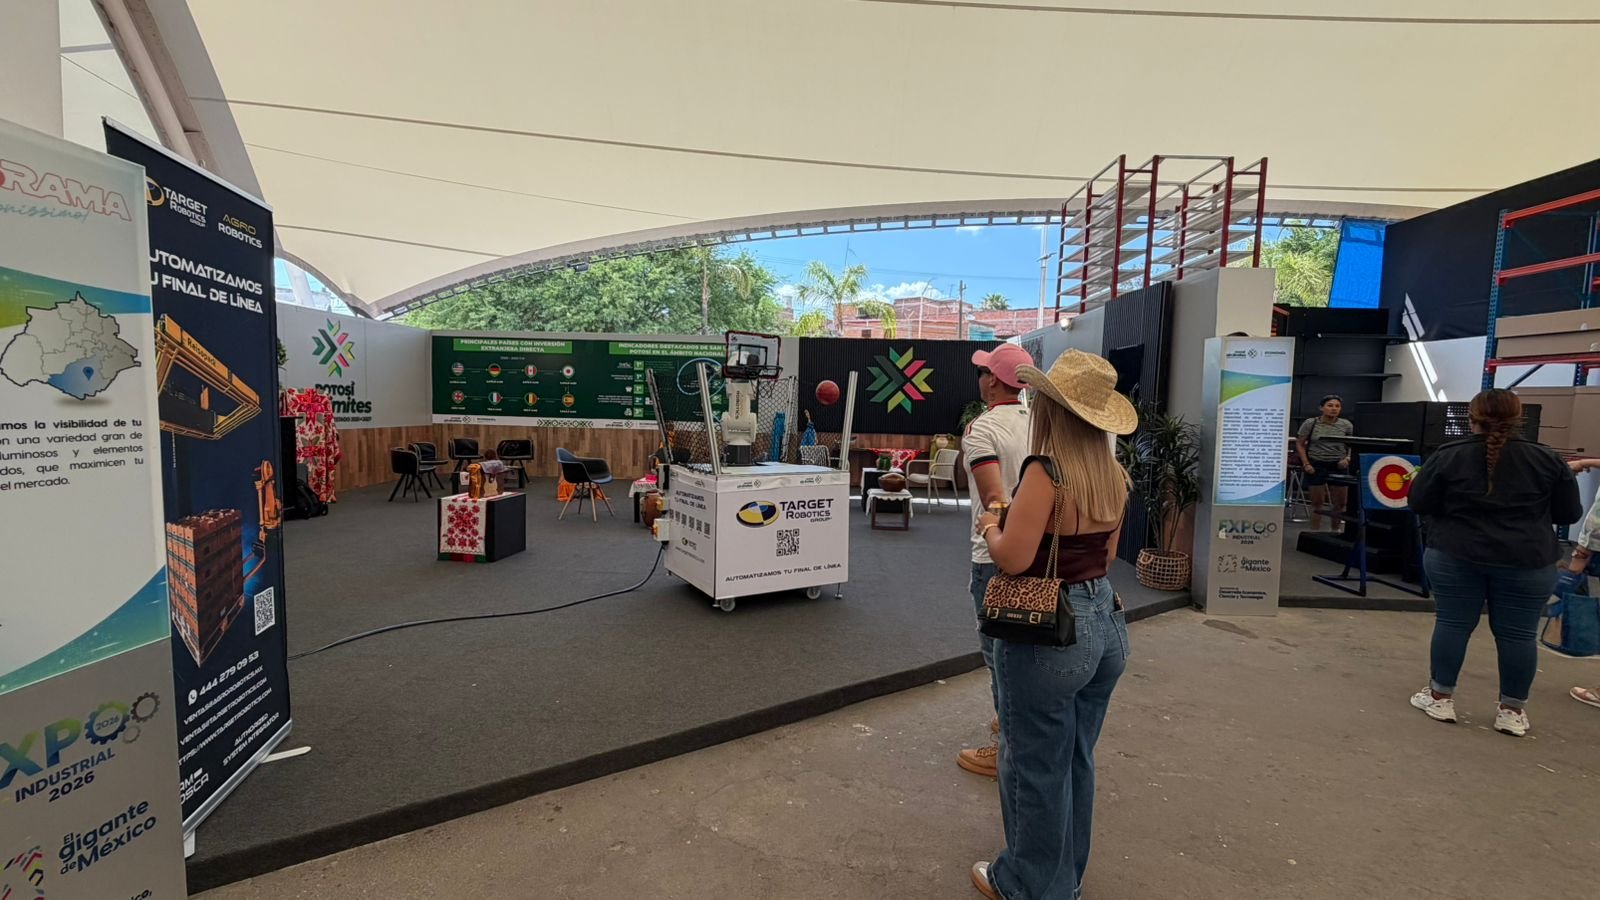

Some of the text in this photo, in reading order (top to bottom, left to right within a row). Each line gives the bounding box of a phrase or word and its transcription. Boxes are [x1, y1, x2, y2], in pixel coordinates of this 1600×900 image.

[163, 186, 208, 216] TARGET
[189, 218, 206, 228] GROUP
[222, 214, 257, 236] AGRO
[217, 222, 263, 249] ROBOTICS
[162, 274, 207, 299] FINAL
[210, 288, 228, 304] DE
[230, 292, 264, 314] LÍNEA
[0, 419, 142, 431] mos la visibilidad de tu
[16, 436, 40, 445] una
[46, 431, 97, 444] variedad
[101, 431, 125, 443] gran
[129, 431, 143, 440] de
[72, 449, 80, 458] y
[93, 444, 143, 455] elementos
[36, 463, 59, 475] que
[69, 459, 126, 471] maximicen
[134, 456, 144, 465] tu
[0, 475, 70, 492] el mercado.
[779, 498, 834, 512] TARGET
[725, 571, 782, 582] AUTOMATIZAMOS
[823, 562, 842, 571] LÍNEA
[1241, 559, 1270, 567] gigante
[199, 650, 260, 697] 444 279 09 53
[95, 714, 120, 732] 2026
[223, 712, 280, 766] SYSTEM INTEGRATOR
[15, 747, 116, 803] INDUSTRIAL
[48, 770, 95, 803] 2026
[59, 800, 149, 864] gigante
[63, 832, 74, 845] El
[77, 816, 157, 872] México
[60, 861, 76, 875] de
